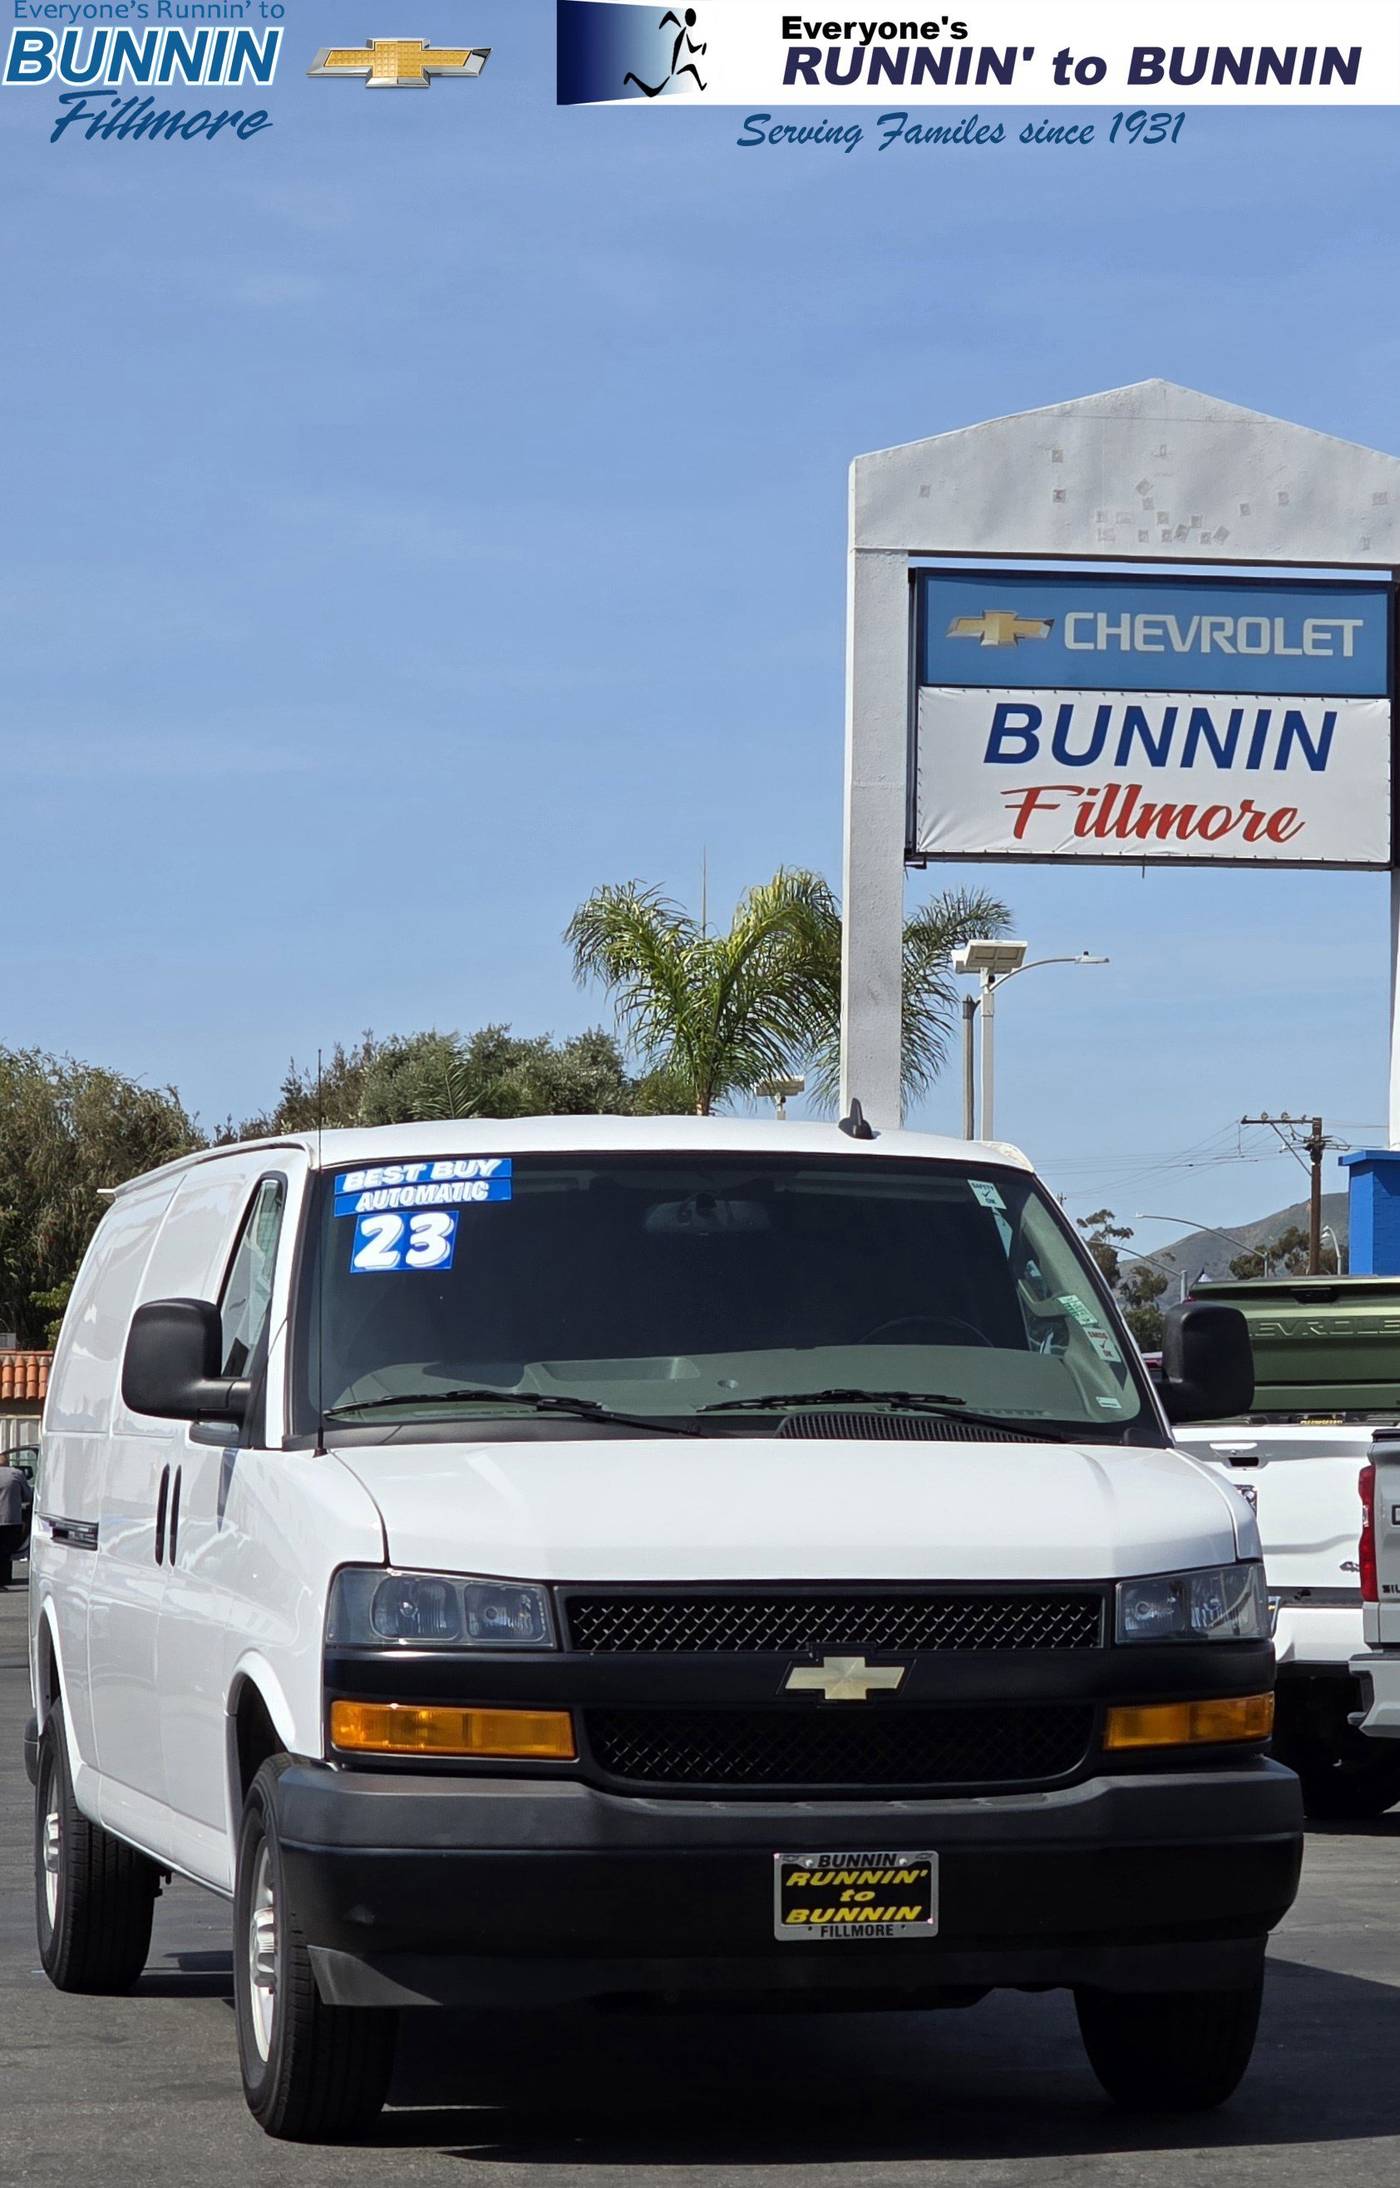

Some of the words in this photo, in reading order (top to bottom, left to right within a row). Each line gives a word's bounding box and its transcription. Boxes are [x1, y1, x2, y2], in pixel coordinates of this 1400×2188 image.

[1064, 612, 1364, 657] CHEVROLET
[983, 702, 1337, 772] BUNNIN
[1000, 783, 1305, 843] Fillmore
[342, 1164, 428, 1192] BEST
[430, 1158, 502, 1180] BUY
[355, 1181, 490, 1213] AUTOMATIC
[353, 1212, 455, 1269] 23
[1249, 1319, 1400, 1337] EVROLE
[817, 1853, 897, 1868] BUNNIN
[786, 1870, 928, 1886] RUNNIN'
[839, 1888, 876, 1902] to
[785, 1906, 922, 1923] BUNNIN
[820, 1924, 894, 1938] FILLMORE
